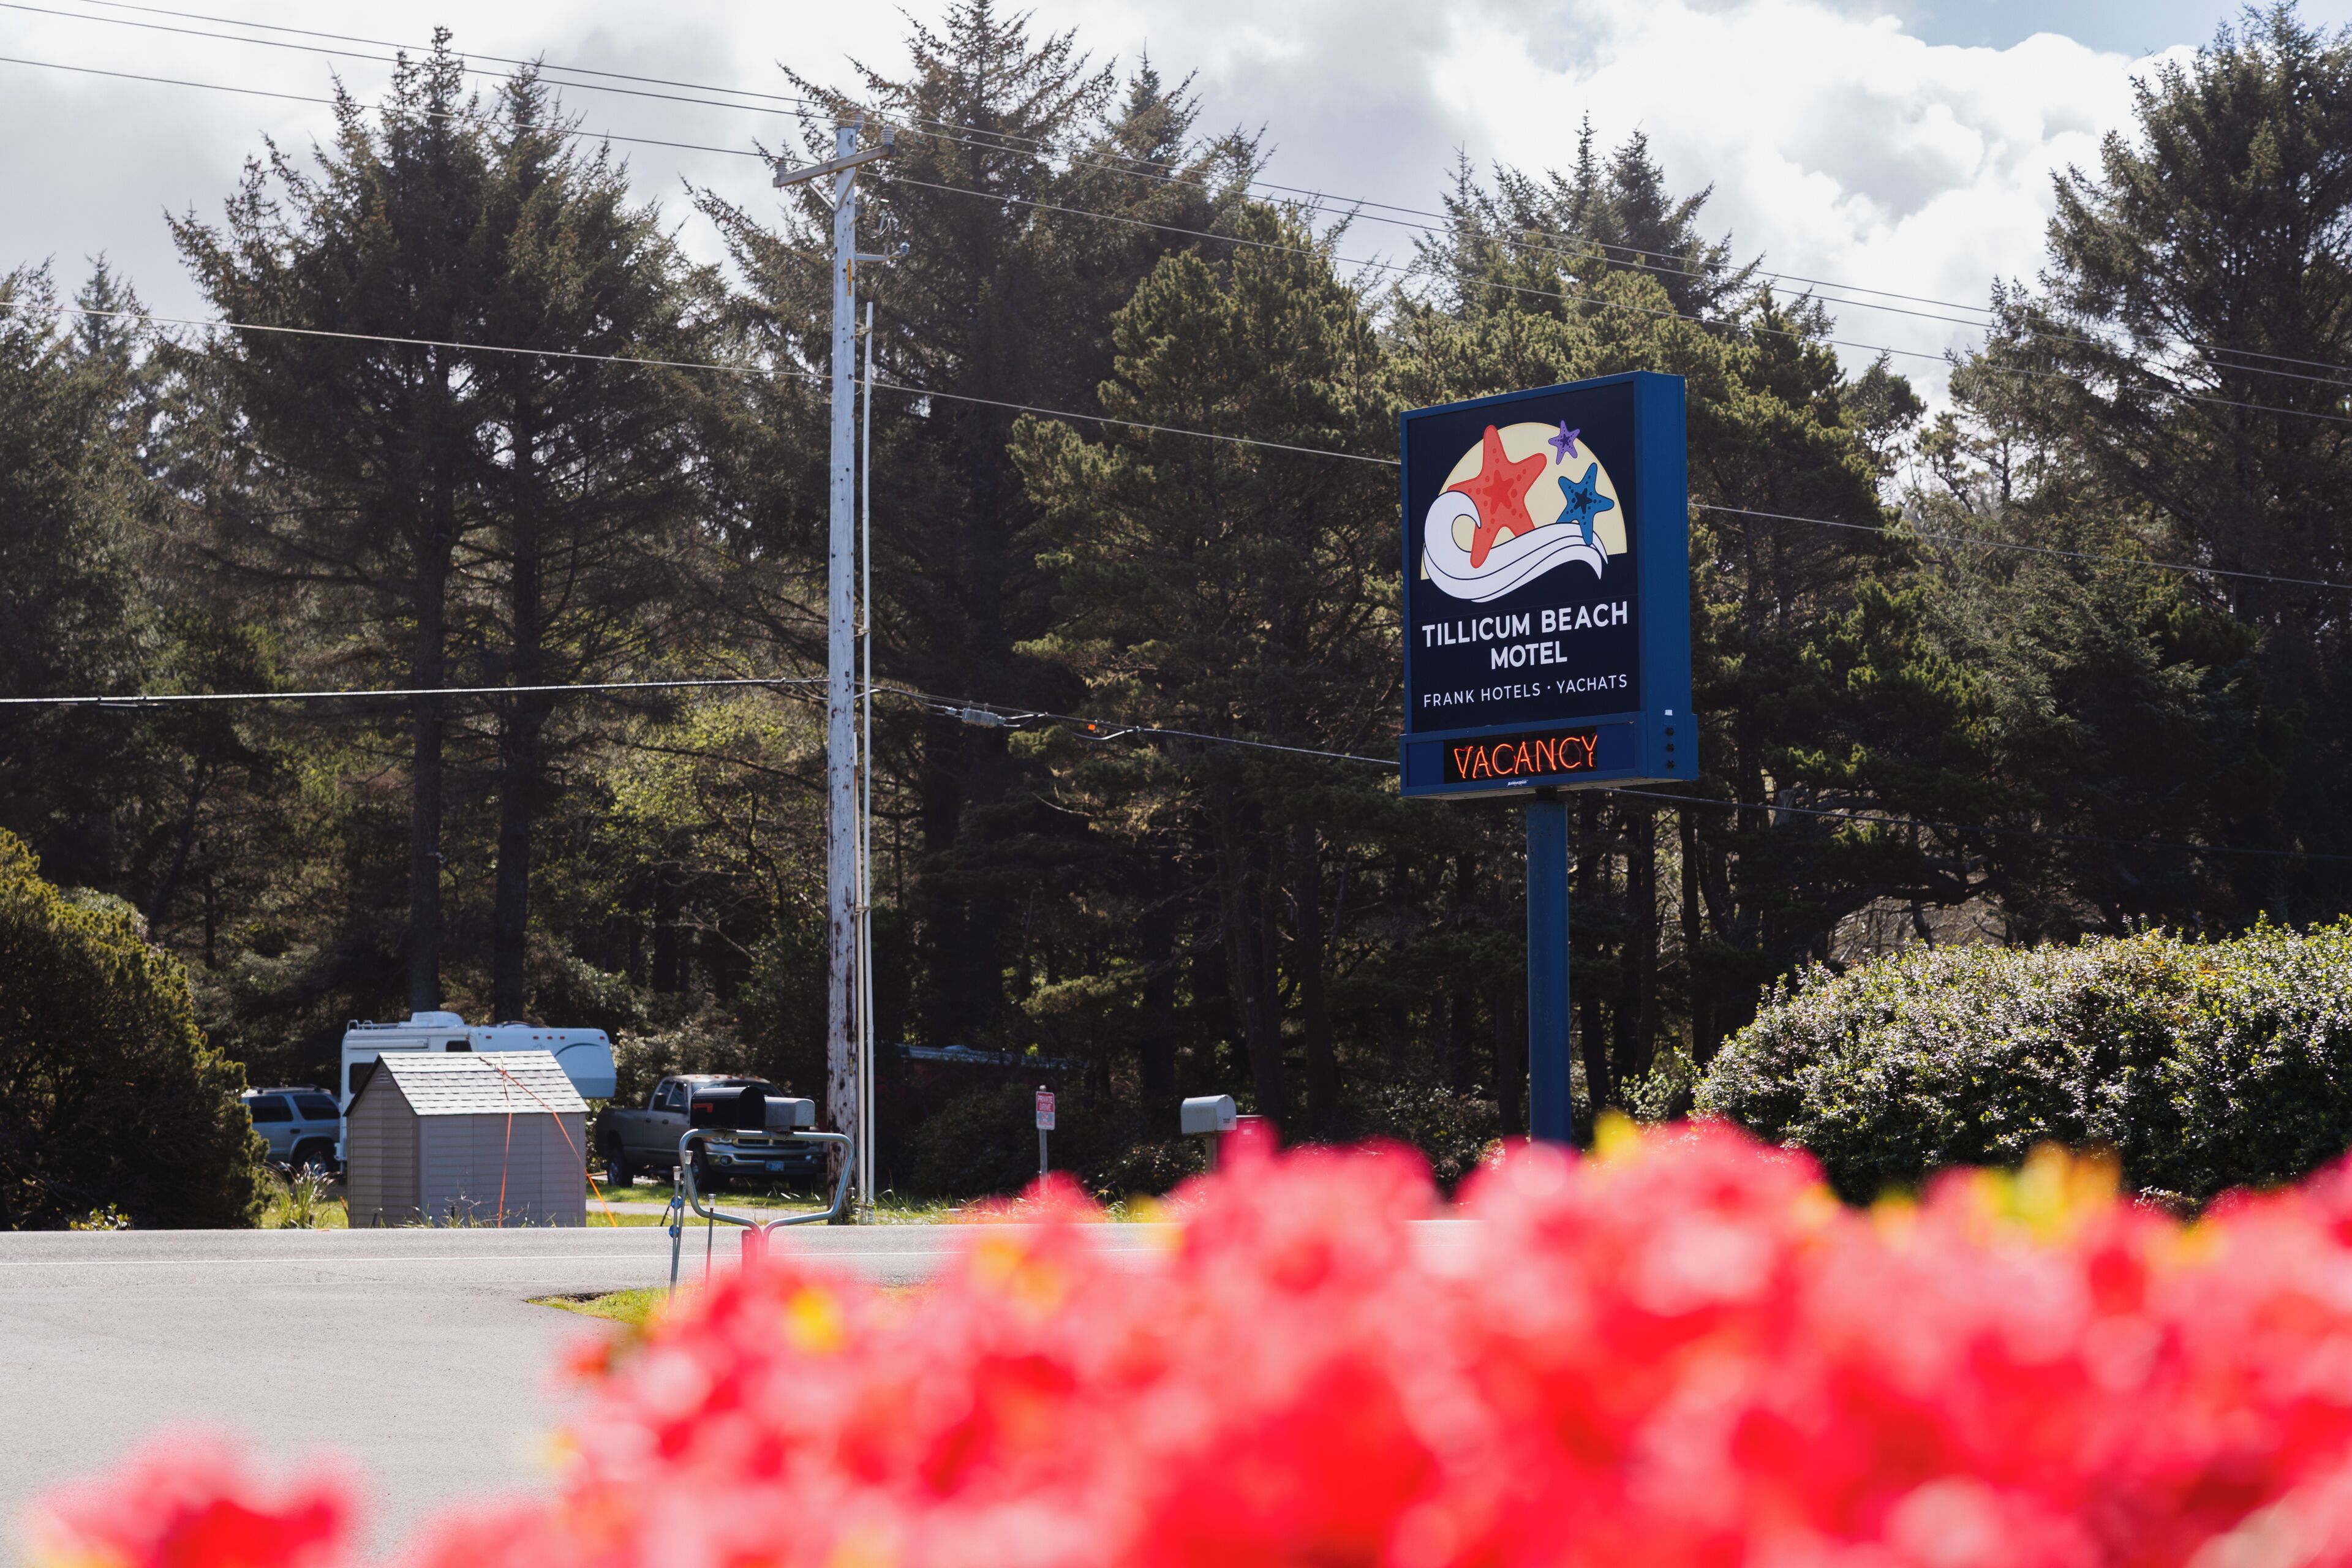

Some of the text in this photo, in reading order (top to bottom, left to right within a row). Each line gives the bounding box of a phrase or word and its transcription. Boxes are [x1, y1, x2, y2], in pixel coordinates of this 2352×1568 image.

[1422, 601, 1627, 647] TILLICUM BEACH
[1491, 641, 1567, 669] MOTEL
[1423, 674, 1627, 707] FRANK HOTELS YACHATS
[1453, 734, 1598, 779] VACANCY
[1038, 1095, 1053, 1104] PRIVATE
